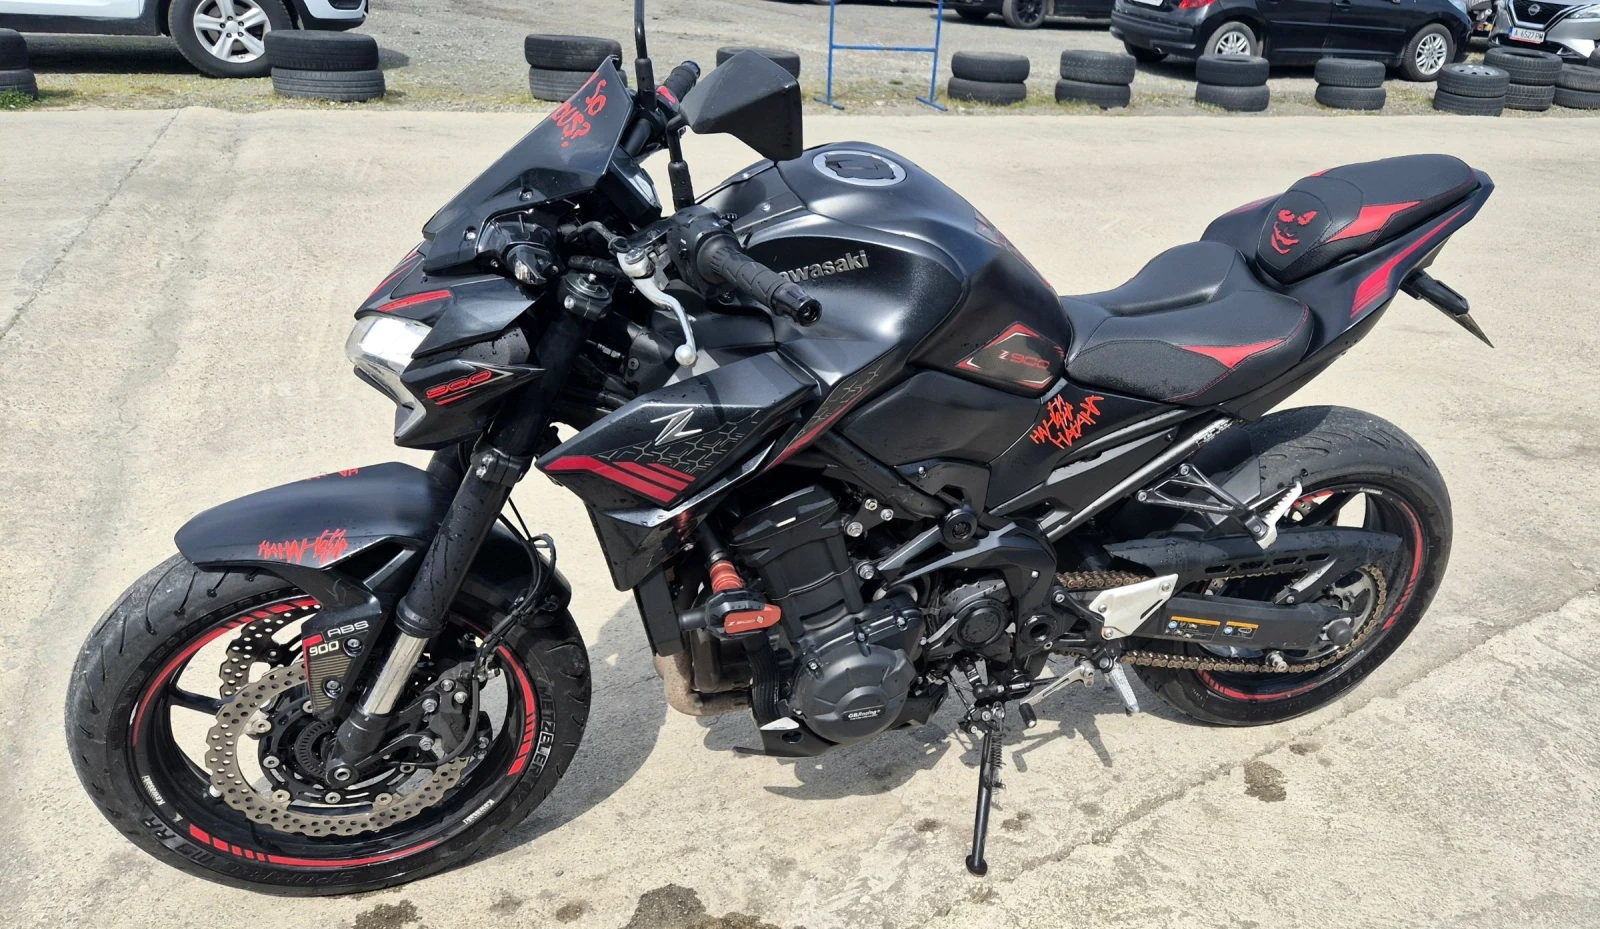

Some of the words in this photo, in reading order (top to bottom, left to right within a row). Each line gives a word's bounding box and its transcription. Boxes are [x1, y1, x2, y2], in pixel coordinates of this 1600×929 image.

[778, 249, 870, 283] awasaki
[327, 620, 369, 638] ABS
[309, 640, 340, 657] 900
[528, 685, 556, 778] METZELER
